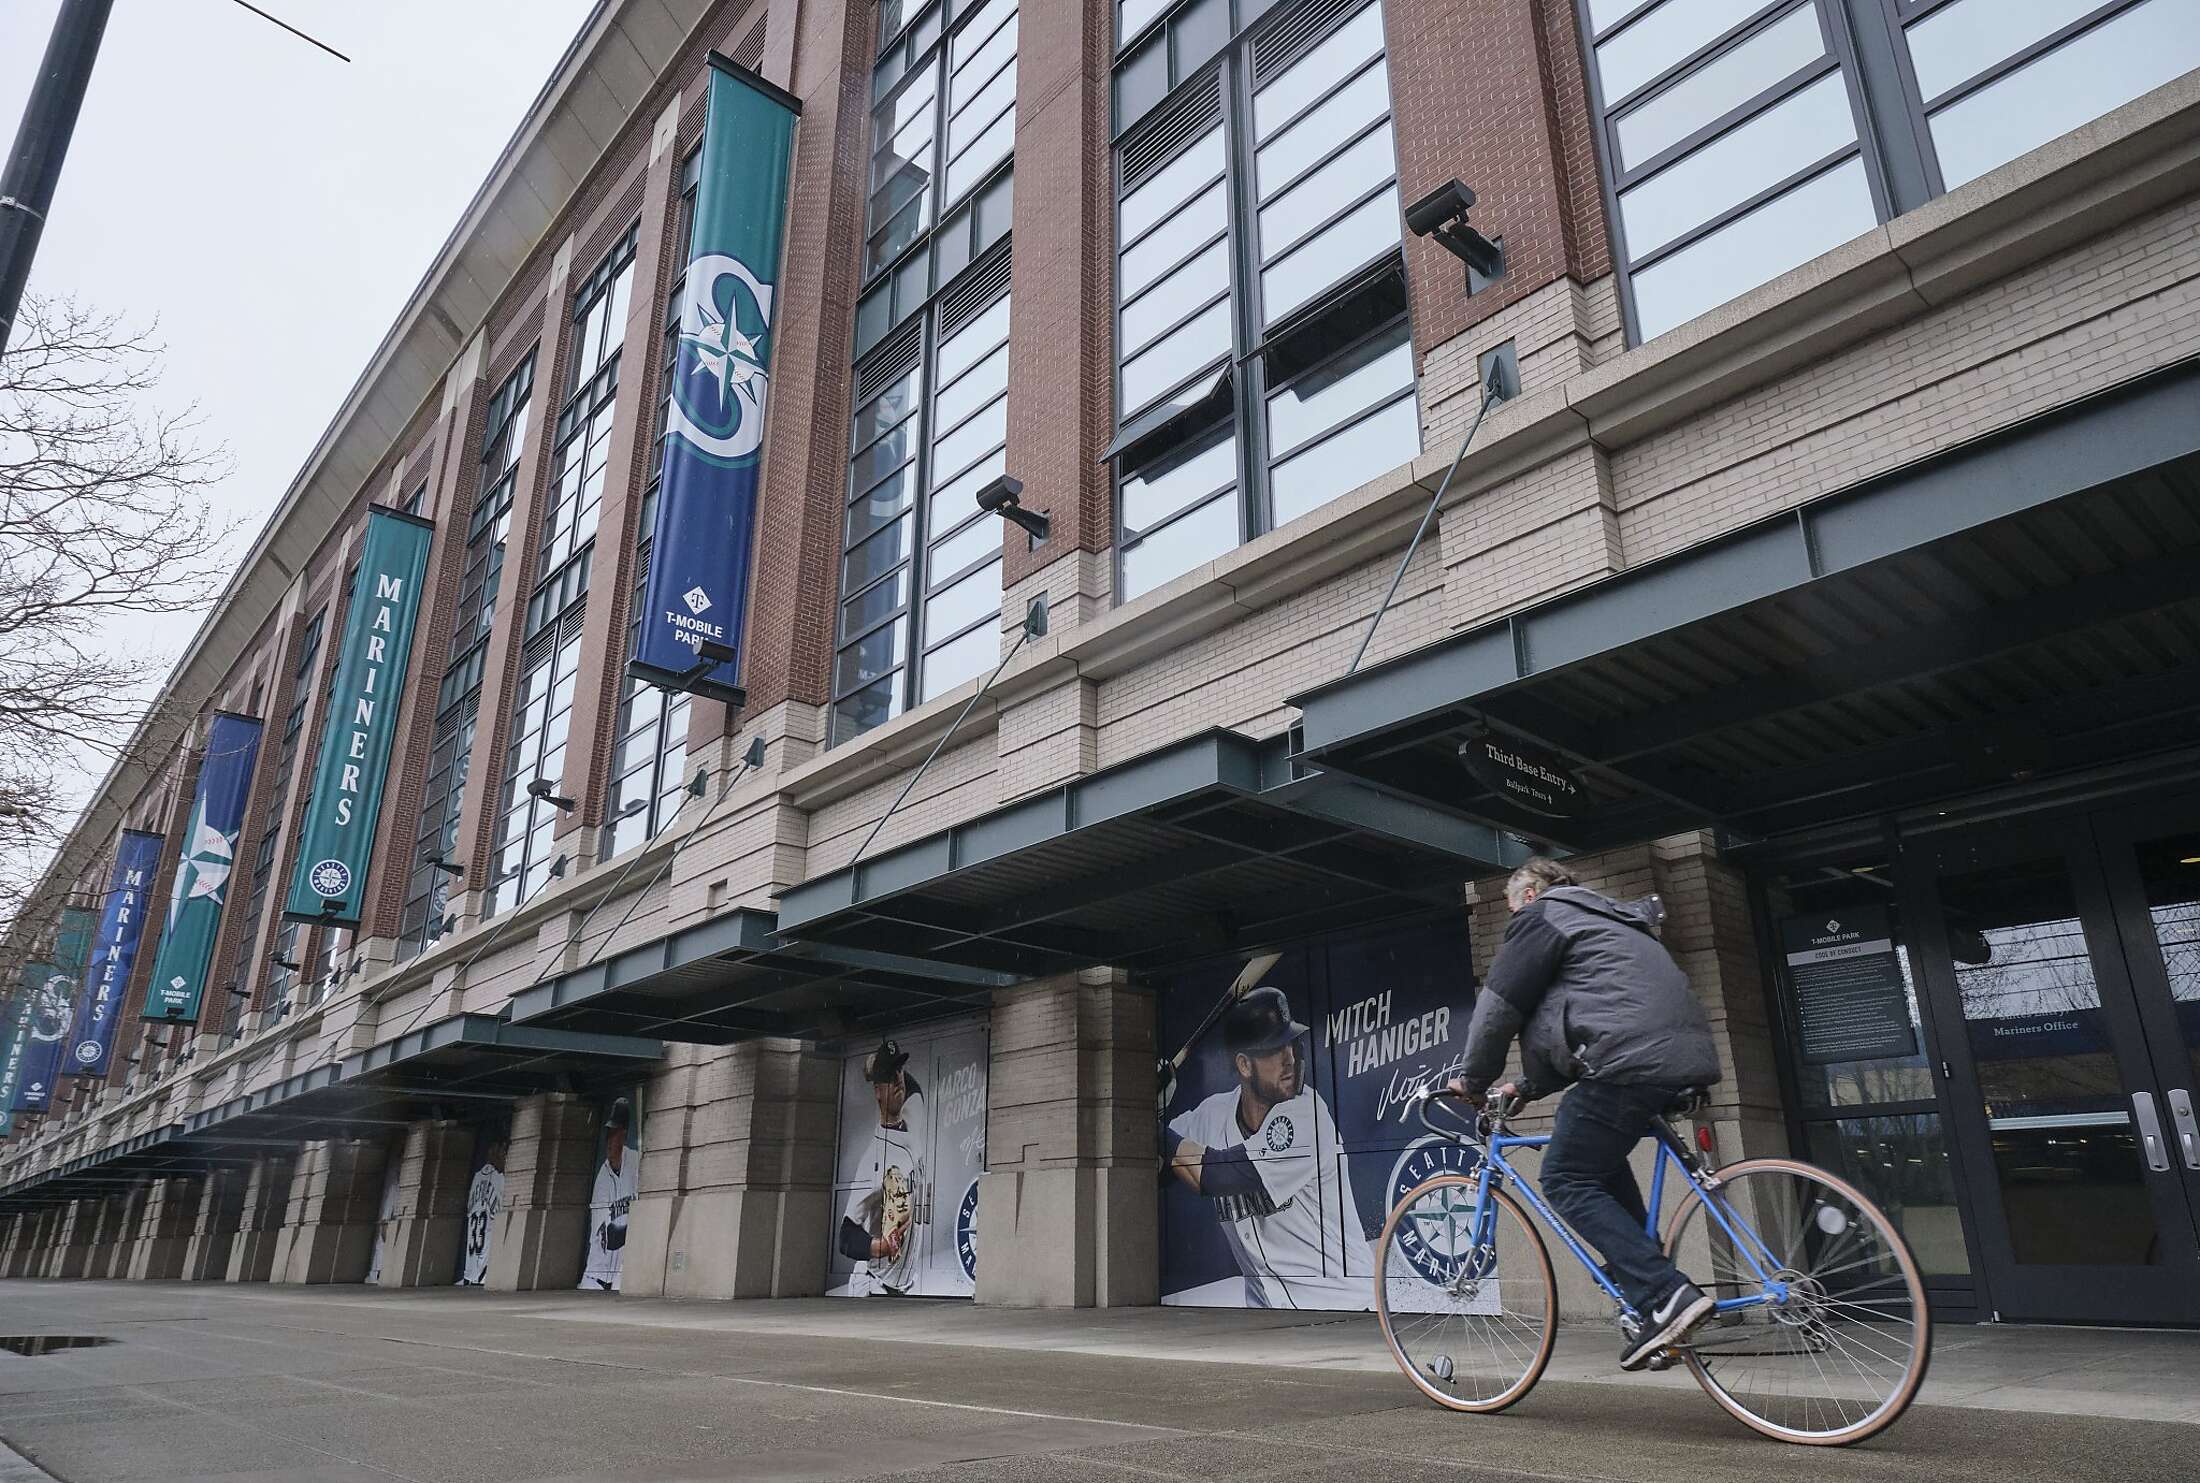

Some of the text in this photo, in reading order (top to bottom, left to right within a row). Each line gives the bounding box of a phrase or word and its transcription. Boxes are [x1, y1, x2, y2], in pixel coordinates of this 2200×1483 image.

[665, 611, 723, 638] T-MOBILE
[675, 629, 709, 645] PAR
[335, 574, 403, 826] MARINERS
[1486, 744, 1567, 791] Third Base Entry
[93, 869, 143, 1022] MARINERS
[1842, 931, 1861, 941] PARK
[1325, 989, 1392, 1048] MITCH
[1994, 1021, 2080, 1036] Mariners Office
[1347, 1006, 1450, 1078] HANIGER
[934, 1062, 977, 1106] MARCO
[944, 1085, 986, 1128] GONZA
[1400, 1147, 1484, 1195] SEATT
[468, 1211, 488, 1256] 33
